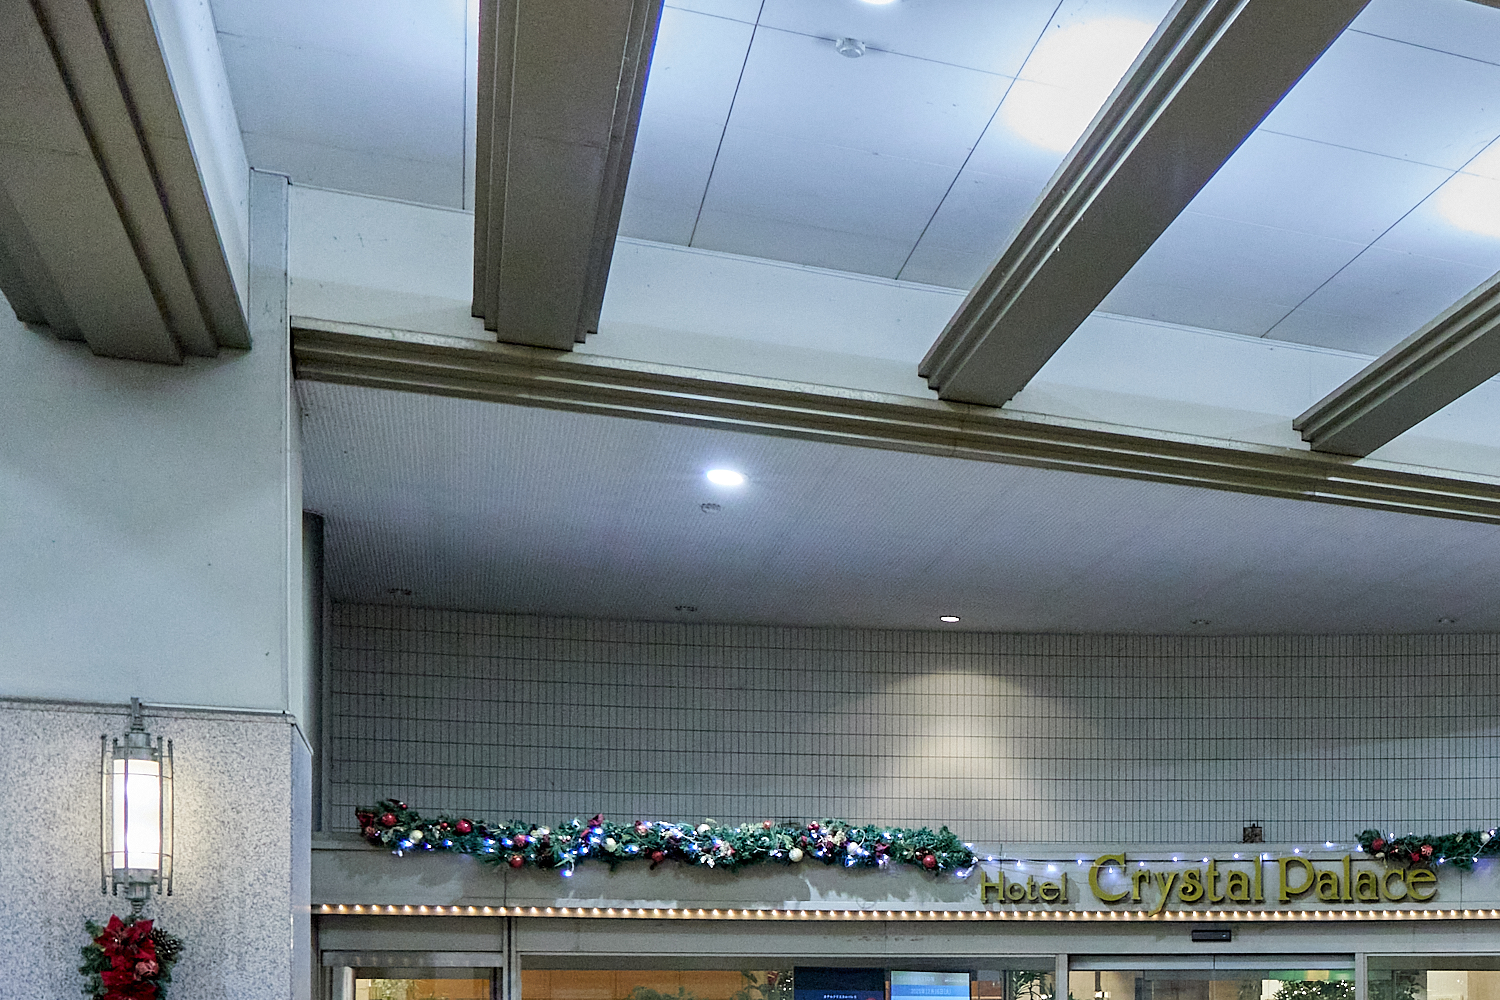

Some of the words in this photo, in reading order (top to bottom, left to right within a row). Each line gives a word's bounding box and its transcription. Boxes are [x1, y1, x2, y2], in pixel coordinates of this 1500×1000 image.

[979, 871, 1068, 904] Hotel
[1088, 852, 1265, 917] Crystal
[1276, 854, 1440, 903] Palace
